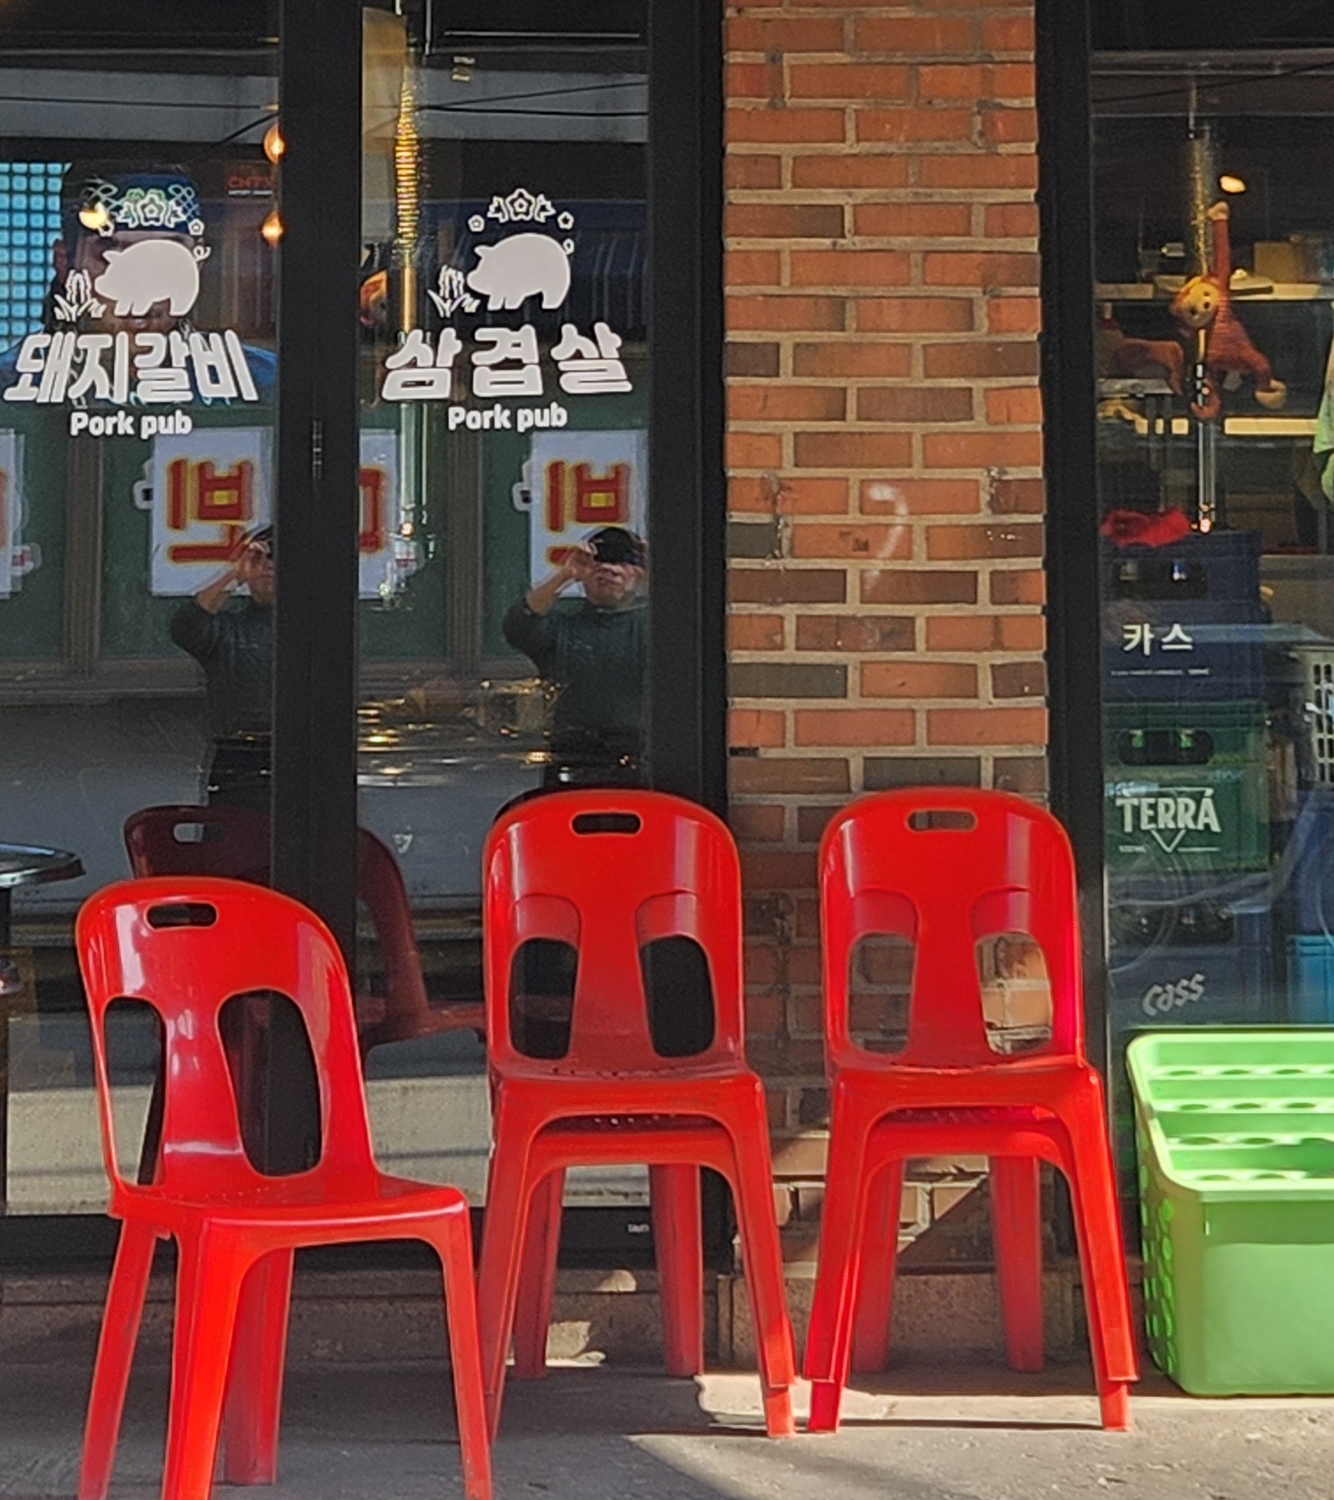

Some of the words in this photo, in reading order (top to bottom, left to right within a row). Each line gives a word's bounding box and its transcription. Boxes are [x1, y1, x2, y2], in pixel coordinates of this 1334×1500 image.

[3, 329, 260, 403] 돼지갈비
[381, 322, 633, 400] 삼겹살
[70, 410, 135, 436] Pork
[140, 409, 193, 440] pub
[447, 403, 512, 431] Pork
[516, 401, 568, 433] pub
[1123, 623, 1193, 656] 카스
[1115, 797, 1222, 833] TERRA
